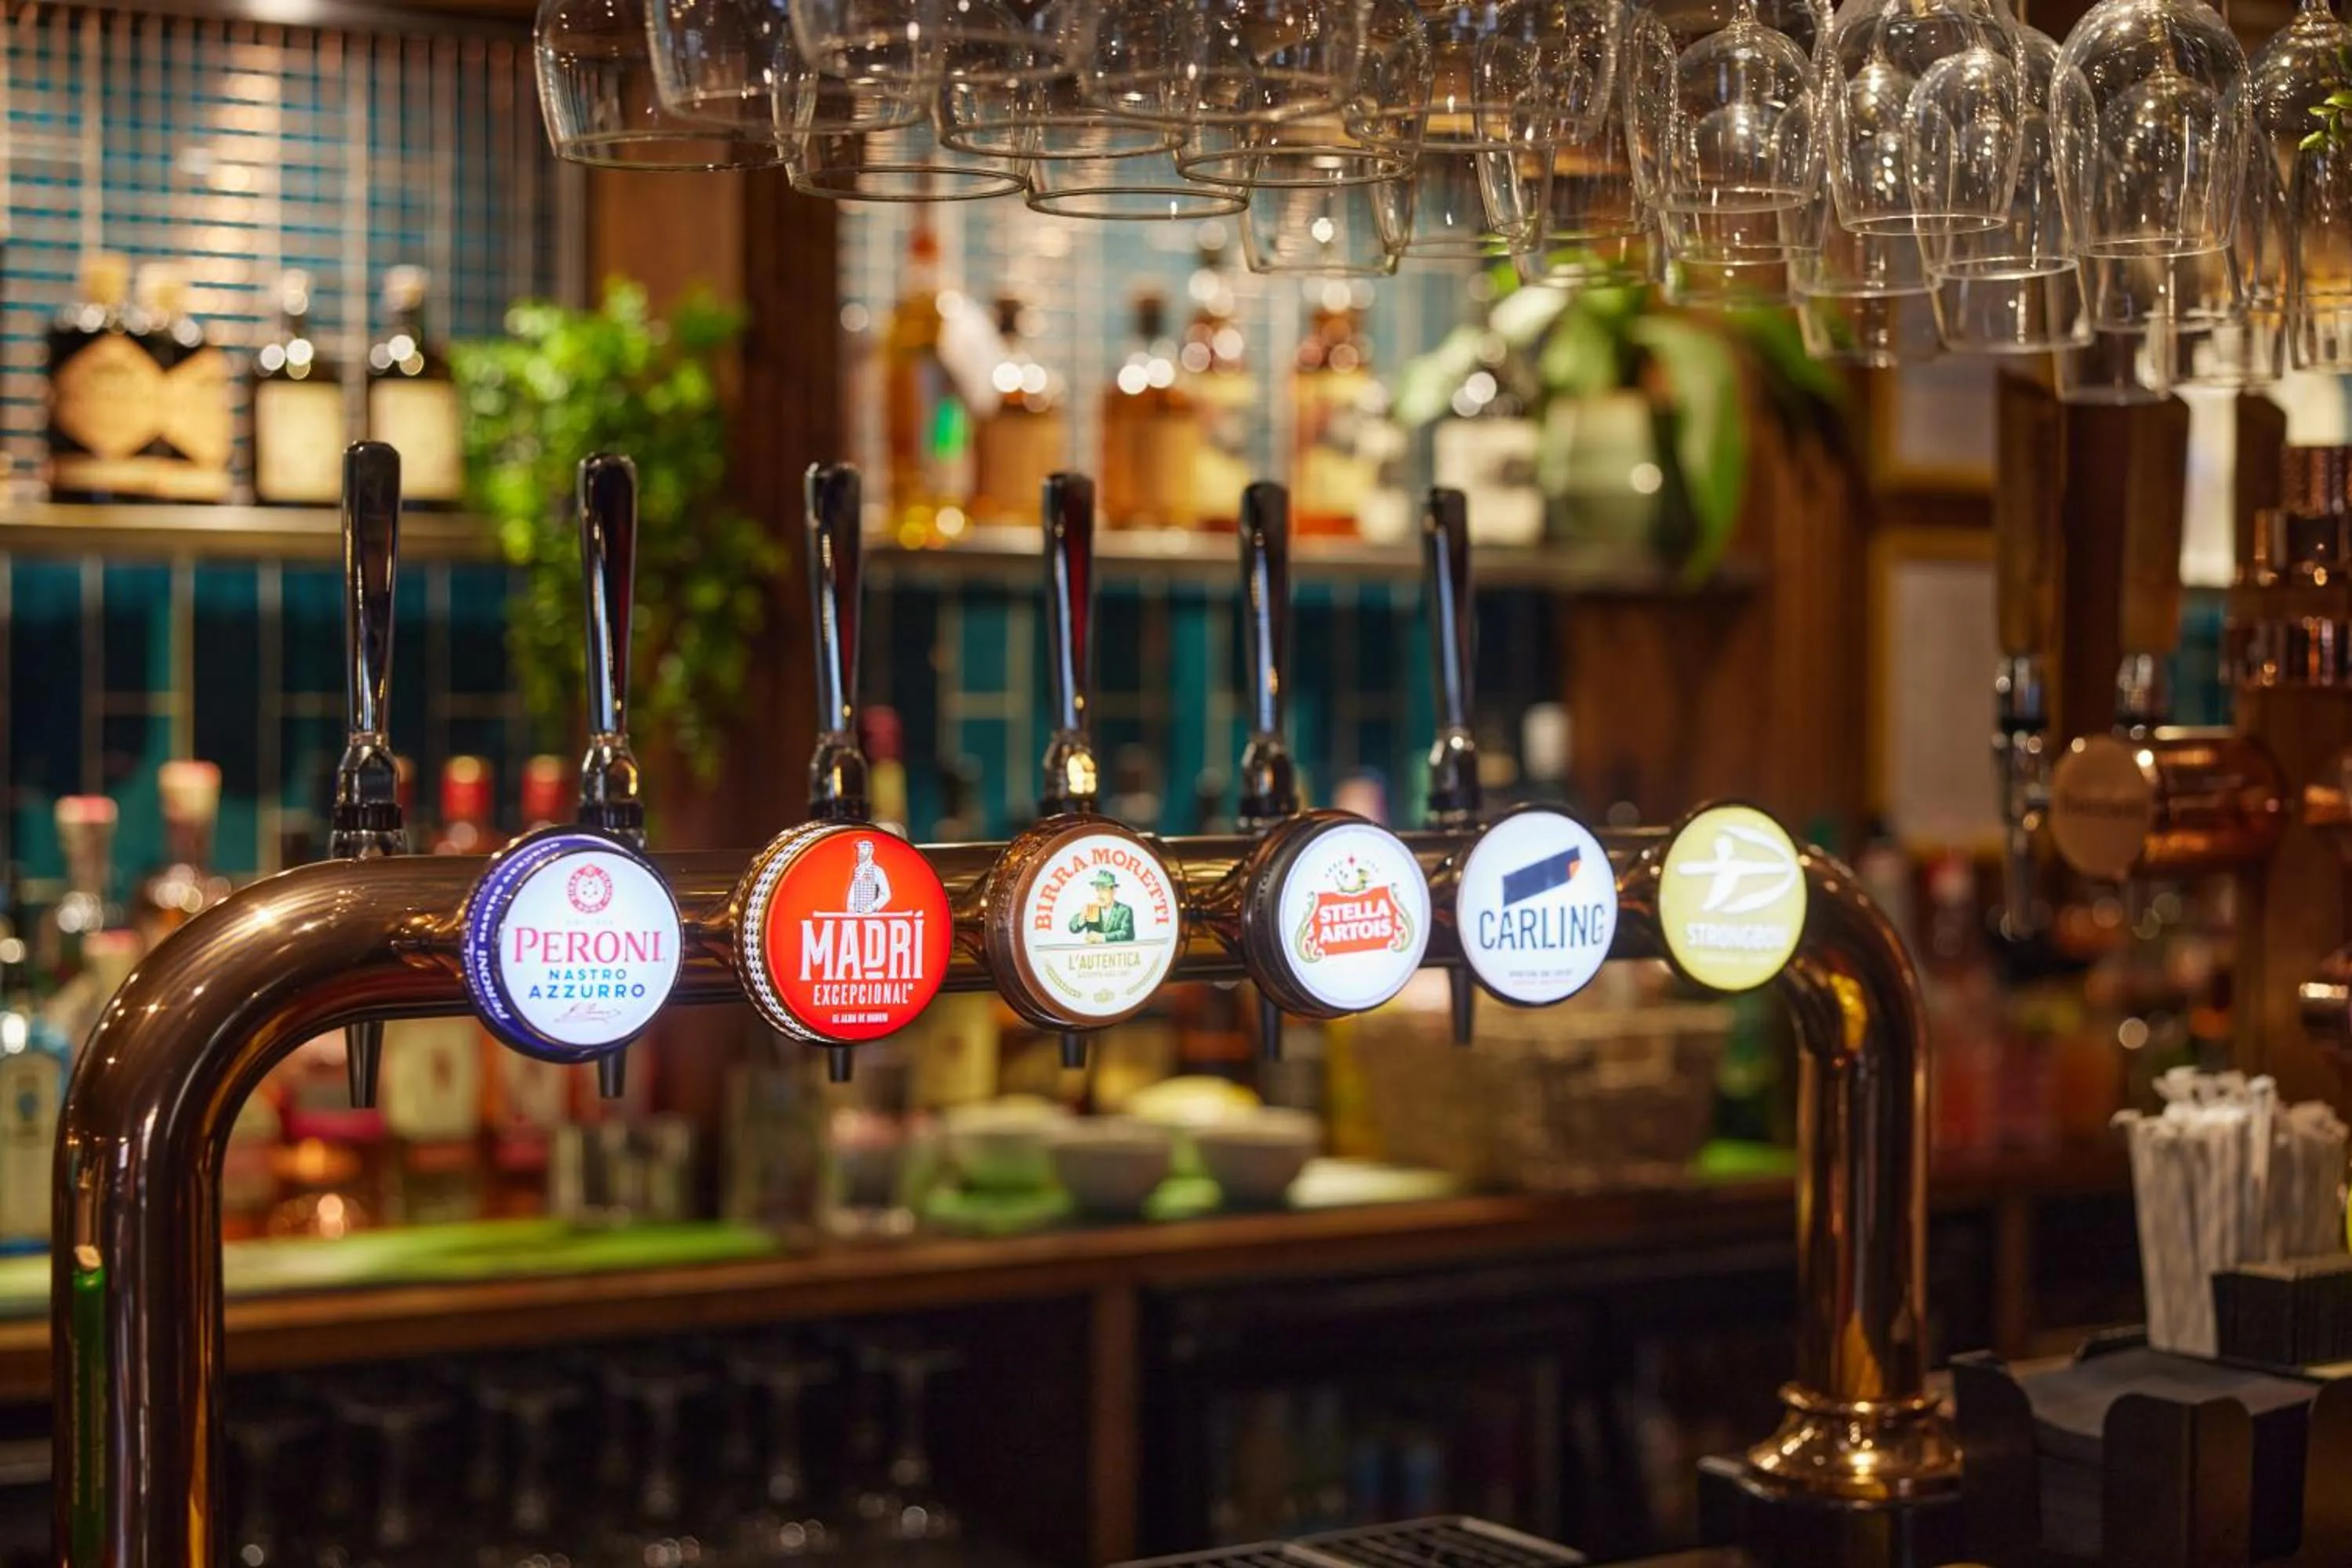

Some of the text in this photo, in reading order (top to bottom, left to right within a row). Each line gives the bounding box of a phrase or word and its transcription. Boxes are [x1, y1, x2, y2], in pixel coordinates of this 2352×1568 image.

[1034, 855, 1088, 931] BIRRA
[1091, 848, 1170, 924] MORETTI
[1319, 899, 1391, 923] STELLA
[1320, 918, 1392, 943] ARTOIS
[1479, 904, 1605, 949] CARLING
[514, 927, 662, 964] PERONI
[800, 910, 924, 981] MADRÍ
[1069, 952, 1142, 971] L'AUTENTICA
[477, 949, 510, 1019] PERONI
[550, 969, 626, 980] NASTRO
[529, 984, 645, 999] AZZURRO
[813, 983, 909, 1005] EXCEPCIONAL
